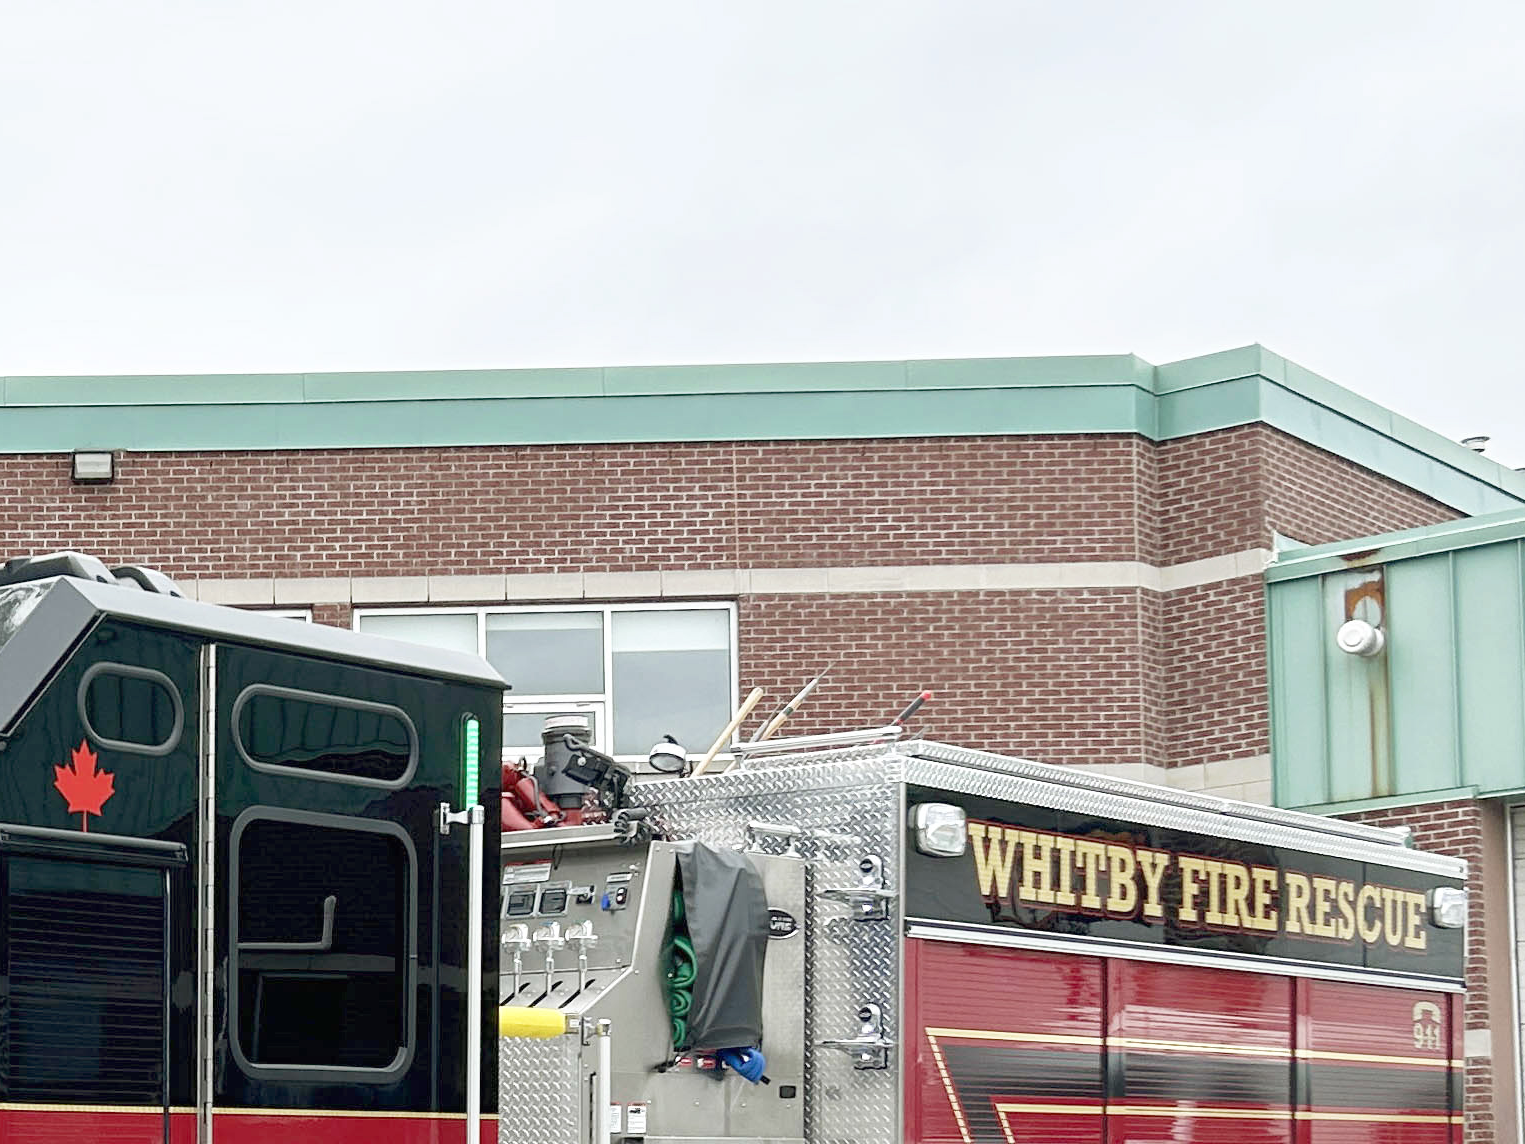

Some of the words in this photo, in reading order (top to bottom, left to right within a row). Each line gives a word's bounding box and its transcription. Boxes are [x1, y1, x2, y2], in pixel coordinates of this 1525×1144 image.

[968, 822, 1170, 918] WHITBY
[1178, 856, 1277, 932] FIRE
[1286, 873, 1427, 951] RESCUE
[1413, 1022, 1441, 1050] 911
